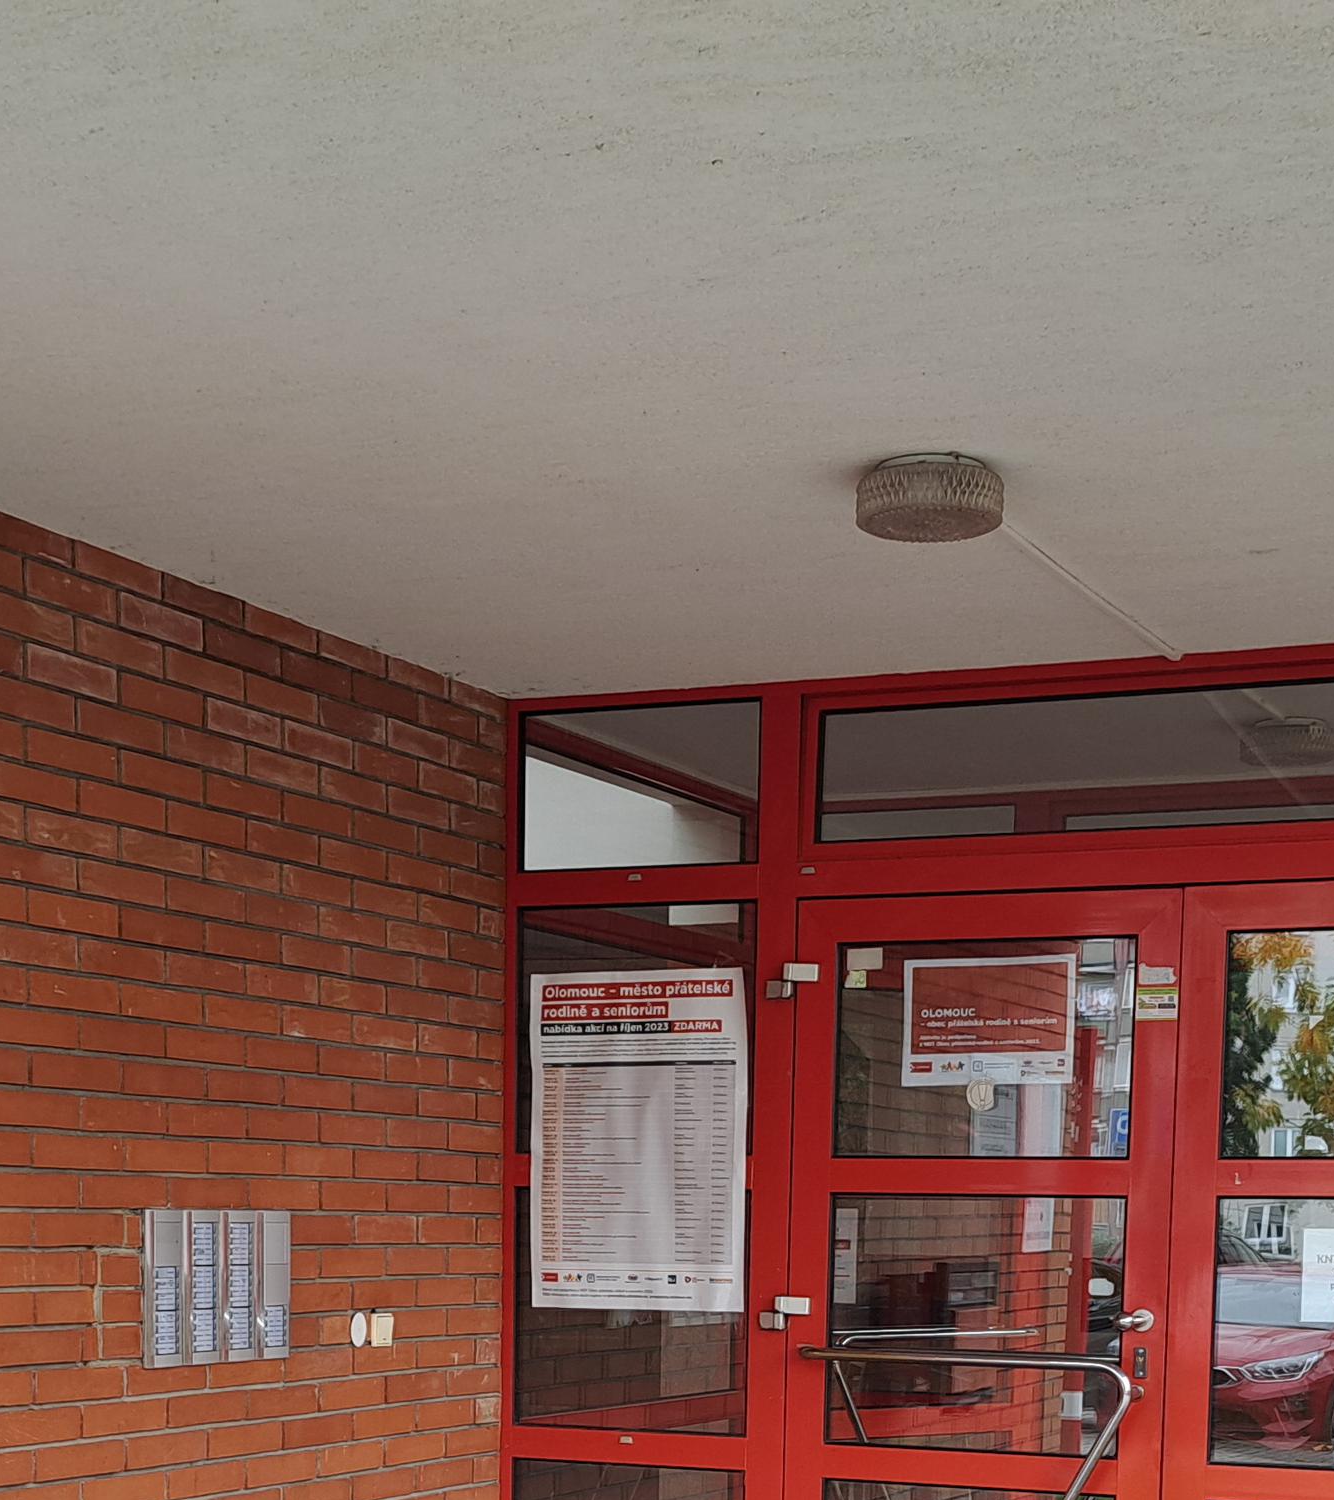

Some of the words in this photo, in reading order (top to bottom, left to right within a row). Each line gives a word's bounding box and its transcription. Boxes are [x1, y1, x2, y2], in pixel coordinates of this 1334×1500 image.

[544, 985, 606, 998] Olomouc
[619, 983, 663, 996] město
[665, 980, 730, 997] přátelské
[543, 1004, 588, 1018] rodině
[591, 1007, 600, 1017] a
[603, 1002, 666, 1017] seniorům
[920, 1007, 976, 1018] OLOMOUC
[543, 1023, 583, 1033] nabídka
[585, 1023, 605, 1033] akcí
[644, 1022, 670, 1032] 2023
[673, 1020, 720, 1031] ZDARMA
